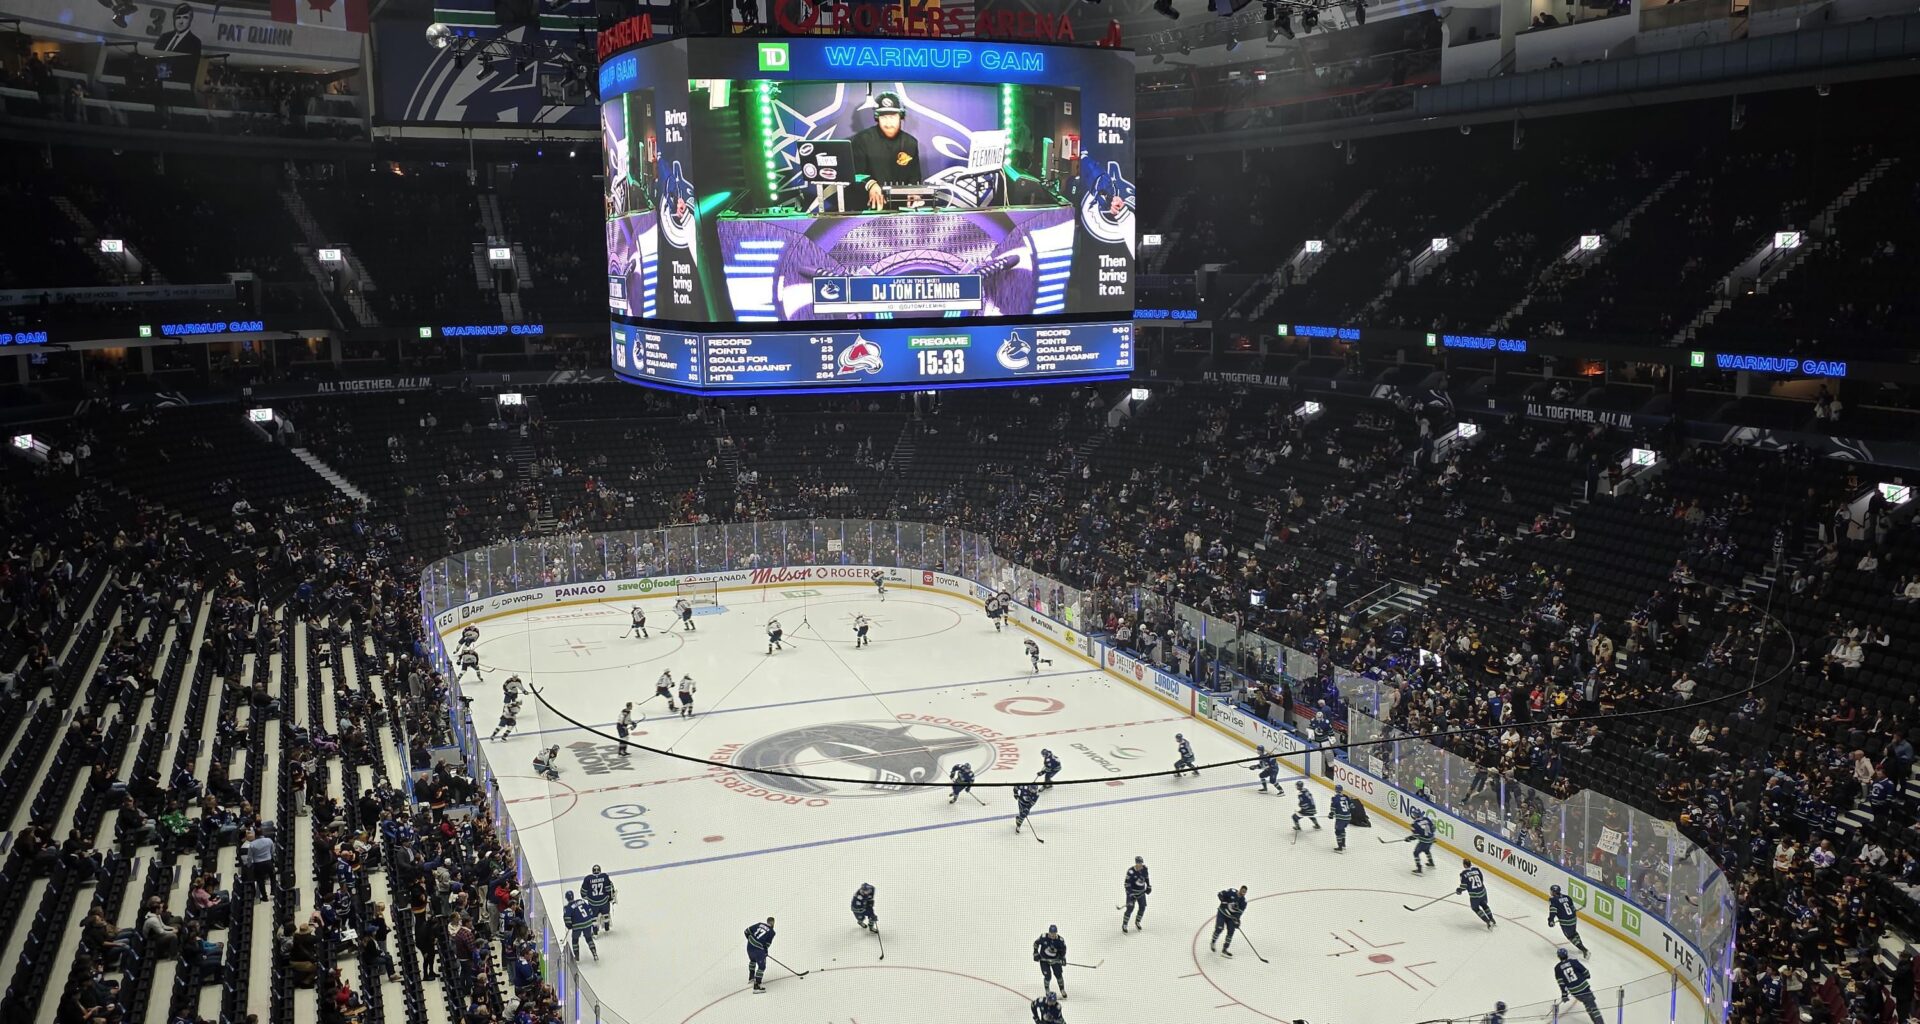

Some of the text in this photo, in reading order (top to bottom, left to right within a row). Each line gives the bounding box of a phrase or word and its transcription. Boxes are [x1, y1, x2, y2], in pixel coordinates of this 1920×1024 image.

[146, 8, 167, 36] 3
[832, 6, 1075, 40] ROGERS ARENA
[218, 24, 294, 46] PAT QUINN
[762, 48, 786, 66] TD
[825, 46, 1044, 71] WARMUP CAM
[665, 110, 688, 128] Bring
[1098, 113, 1131, 131] Bring
[666, 127, 683, 142] it in.
[1098, 130, 1124, 144] it in.
[972, 148, 1003, 166] FLEMING
[672, 260, 690, 274] Then
[1098, 255, 1126, 267] Then
[672, 276, 692, 292] bring
[1099, 270, 1127, 283] bring
[674, 291, 691, 304] it on.
[872, 283, 960, 300] DJ TOM FLEMING
[1099, 284, 1125, 296] it on.
[1172, 310, 1197, 320] CAM
[162, 324, 226, 335] WARMUP
[230, 321, 263, 332] CAM
[442, 326, 507, 336] WARMUP
[511, 325, 544, 335] CAM
[1294, 325, 1337, 338] WARMUP
[1339, 329, 1360, 340] CAM
[15, 332, 48, 343] CAM
[912, 338, 968, 346] PREGAME
[1443, 336, 1496, 349] WARMUP
[1498, 340, 1527, 351] CAM
[710, 364, 746, 372] GOALS
[747, 364, 792, 372] AGAINST
[918, 350, 964, 375] 15:33
[1717, 354, 1798, 372] WARMUP
[1802, 360, 1846, 376] CAM
[318, 377, 432, 393] ALL TOGETHER. ALL IN.
[1203, 372, 1289, 386] ALL TOGETHER. ALL IN.
[1527, 404, 1543, 416] ALL
[1600, 412, 1616, 426] ALL
[1620, 414, 1633, 428] IN.
[713, 574, 747, 582] CANADA
[750, 567, 812, 585] Molson
[830, 568, 876, 578] ROGERS
[935, 576, 959, 588] TOYOTA
[555, 584, 606, 598] PANAGO
[502, 593, 543, 606] DP WORLD
[438, 613, 453, 628] KEG
[1116, 652, 1134, 672] SHELTER
[1155, 673, 1179, 696] LORDCO
[919, 714, 1019, 770] ROGERS ARENA
[573, 747, 610, 776] NOW
[707, 743, 744, 775] AENA
[1082, 751, 1121, 773] WORLD
[1334, 764, 1374, 795] ROGERS
[615, 821, 655, 849] Clio
[1488, 842, 1495, 856] IS
[1495, 845, 1503, 858] IT
[1517, 858, 1537, 877] YOU?
[592, 883, 604, 896] 32
[1468, 875, 1482, 889] 29
[1570, 882, 1585, 899] TD
[578, 905, 587, 918] 5
[1563, 902, 1572, 915] 6
[1598, 897, 1612, 913] TD
[1624, 911, 1639, 929] TD
[1663, 932, 1694, 972] THE
[1563, 967, 1578, 983] 13
